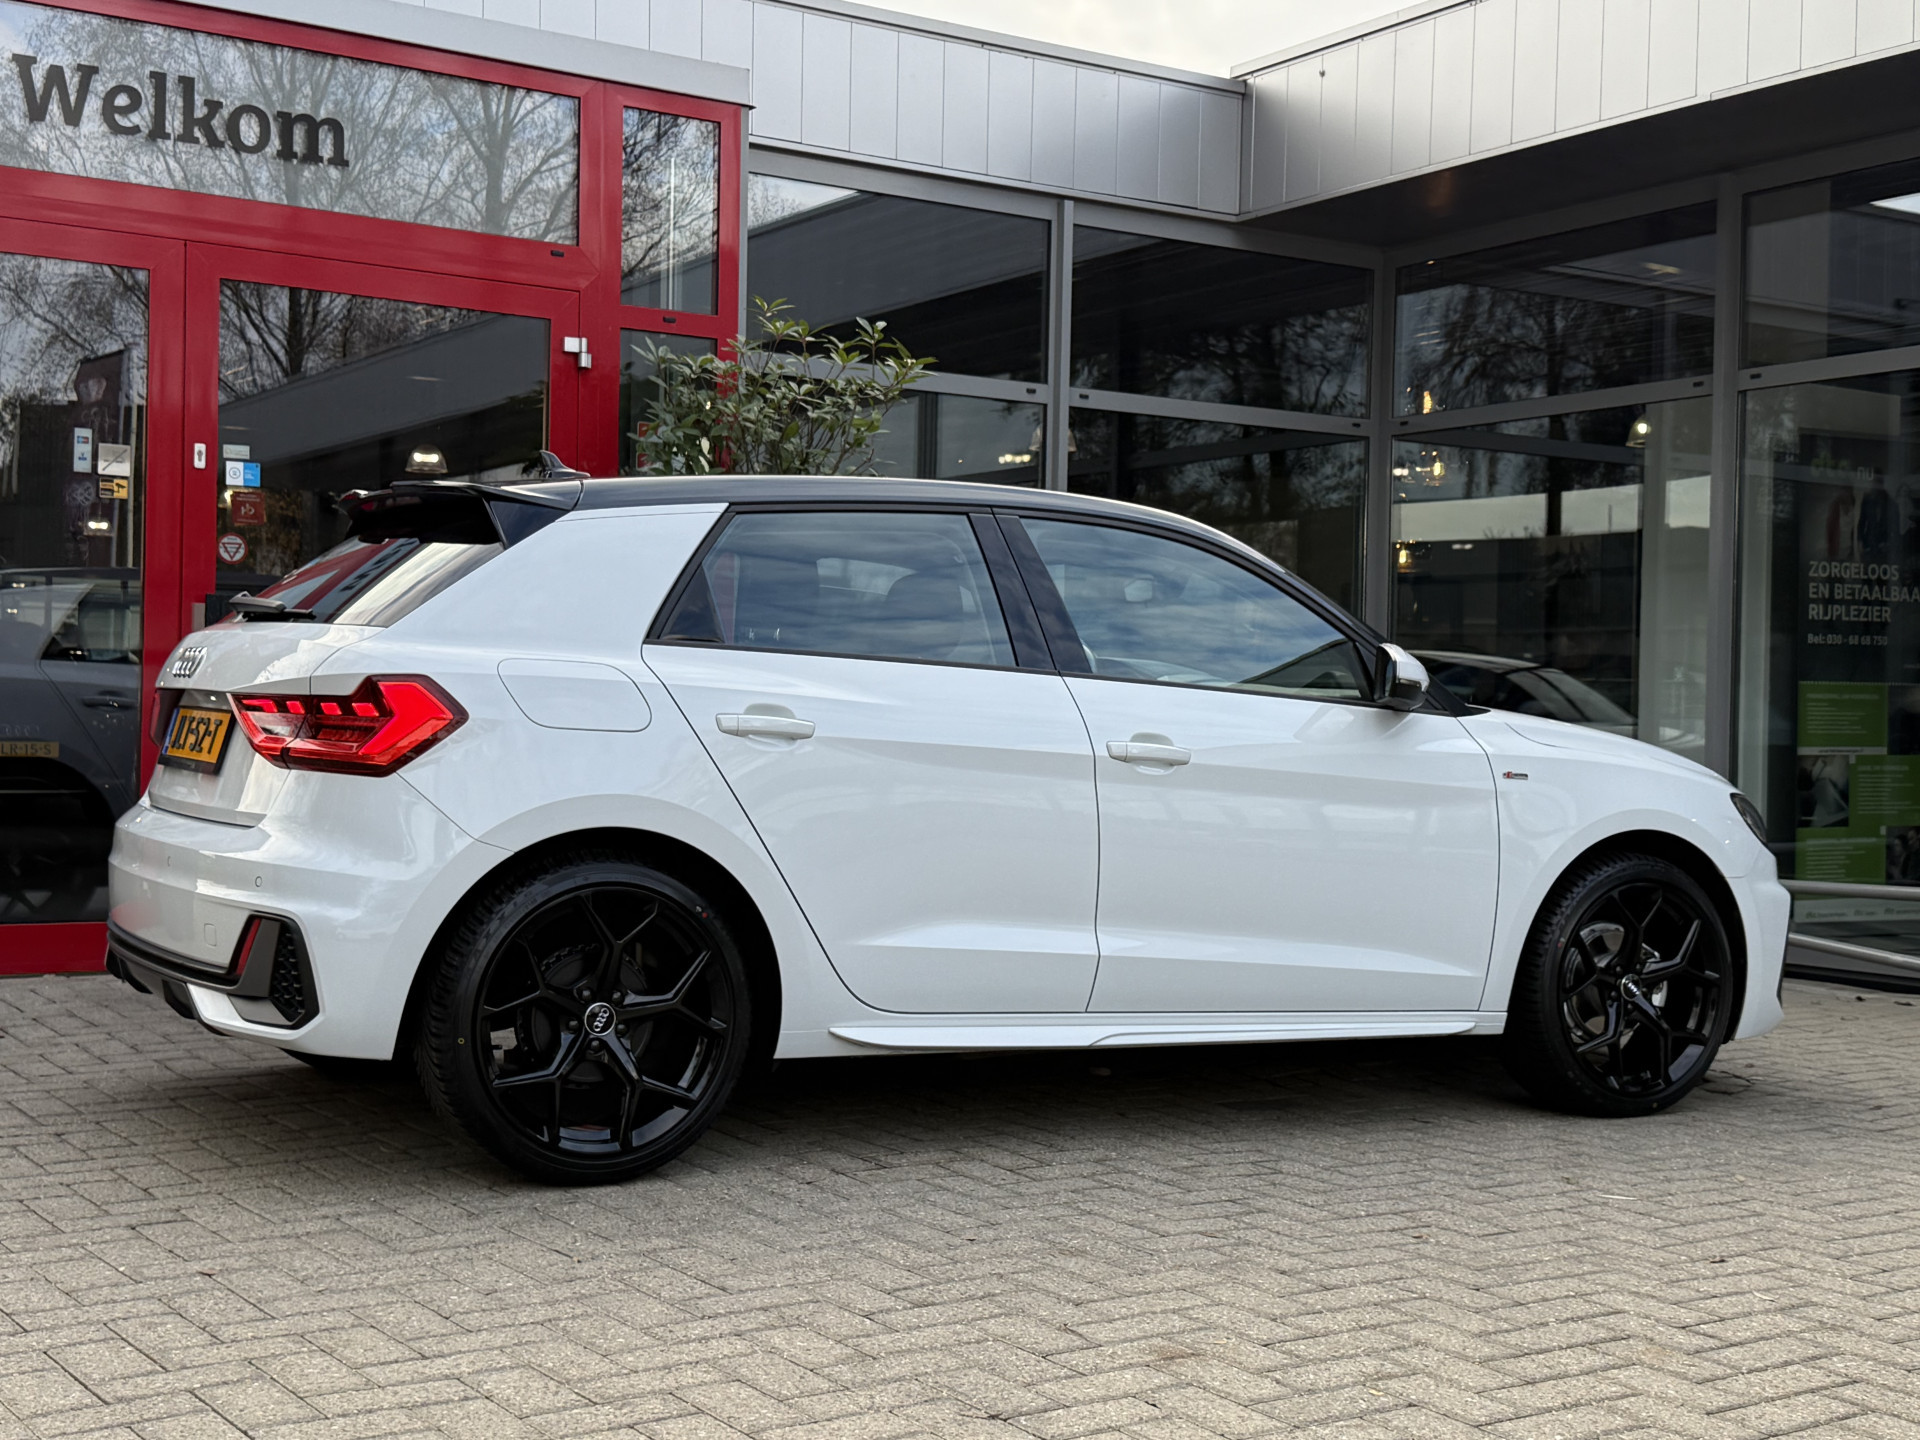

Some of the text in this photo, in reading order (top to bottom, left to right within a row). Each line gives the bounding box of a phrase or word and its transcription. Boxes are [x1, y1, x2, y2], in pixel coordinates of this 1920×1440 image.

[11, 53, 350, 167] Welkom
[1808, 561, 1900, 580] ZORGELOOS
[1808, 582, 1830, 599] EN
[1808, 603, 1892, 622] RIJPLEZIER
[1807, 633, 1826, 644] Bel:
[1826, 634, 1842, 645] 030
